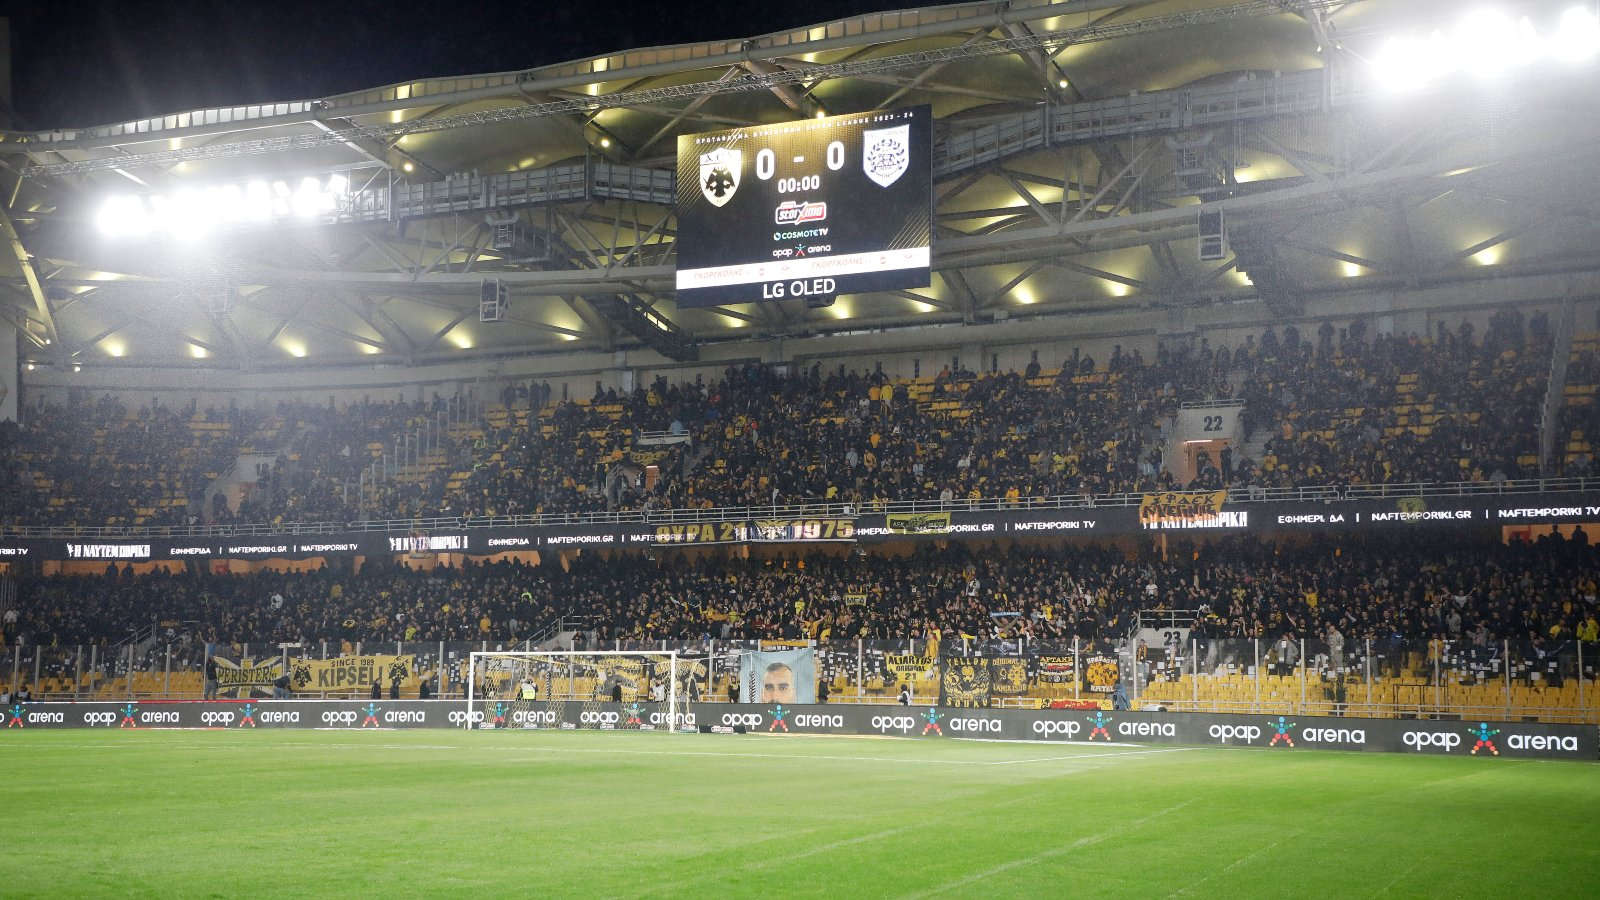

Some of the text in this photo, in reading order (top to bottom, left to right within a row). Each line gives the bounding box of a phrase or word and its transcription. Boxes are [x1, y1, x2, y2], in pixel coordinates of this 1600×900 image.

[756, 149, 775, 180] 0
[827, 141, 845, 170] 0
[778, 176, 820, 193] 00:00
[773, 245, 831, 258] opap arena
[763, 279, 835, 299] LG OLED
[1203, 416, 1222, 431] 22
[1372, 510, 1471, 521] NAFTEMPORIKI.GR
[1499, 506, 1600, 517] NAFTEMPORIKI TV
[656, 523, 716, 543] ΘΥΡΑ
[793, 520, 853, 538] 1975
[1015, 520, 1095, 530] NAFTEMPORIKI TV
[488, 538, 529, 546] ΕΦΗΜΕΡΙΔΑ
[547, 535, 614, 544] NAFTEMPORIKI.GR
[170, 547, 211, 555] ΕΦΗΜΕΡΙΔΑ
[228, 546, 287, 554] NAFTEMPORIKI.GR
[1164, 631, 1181, 646] 23
[331, 658, 355, 667] SINCE
[946, 657, 988, 667] YELLOW
[318, 666, 382, 688] KIPSELI
[29, 712, 64, 723] arena
[84, 711, 180, 726] opap arena
[201, 711, 299, 726] opap arena
[322, 711, 425, 726] opap arena
[448, 711, 484, 726] opap
[513, 711, 556, 722] arena
[650, 712, 696, 724] arena
[722, 713, 762, 730] opap
[795, 714, 843, 727] arena
[871, 715, 1001, 733] opap arena
[1033, 719, 1175, 738] opap arena
[1209, 724, 1365, 744] opap arena
[1403, 729, 1578, 752] opap arena
